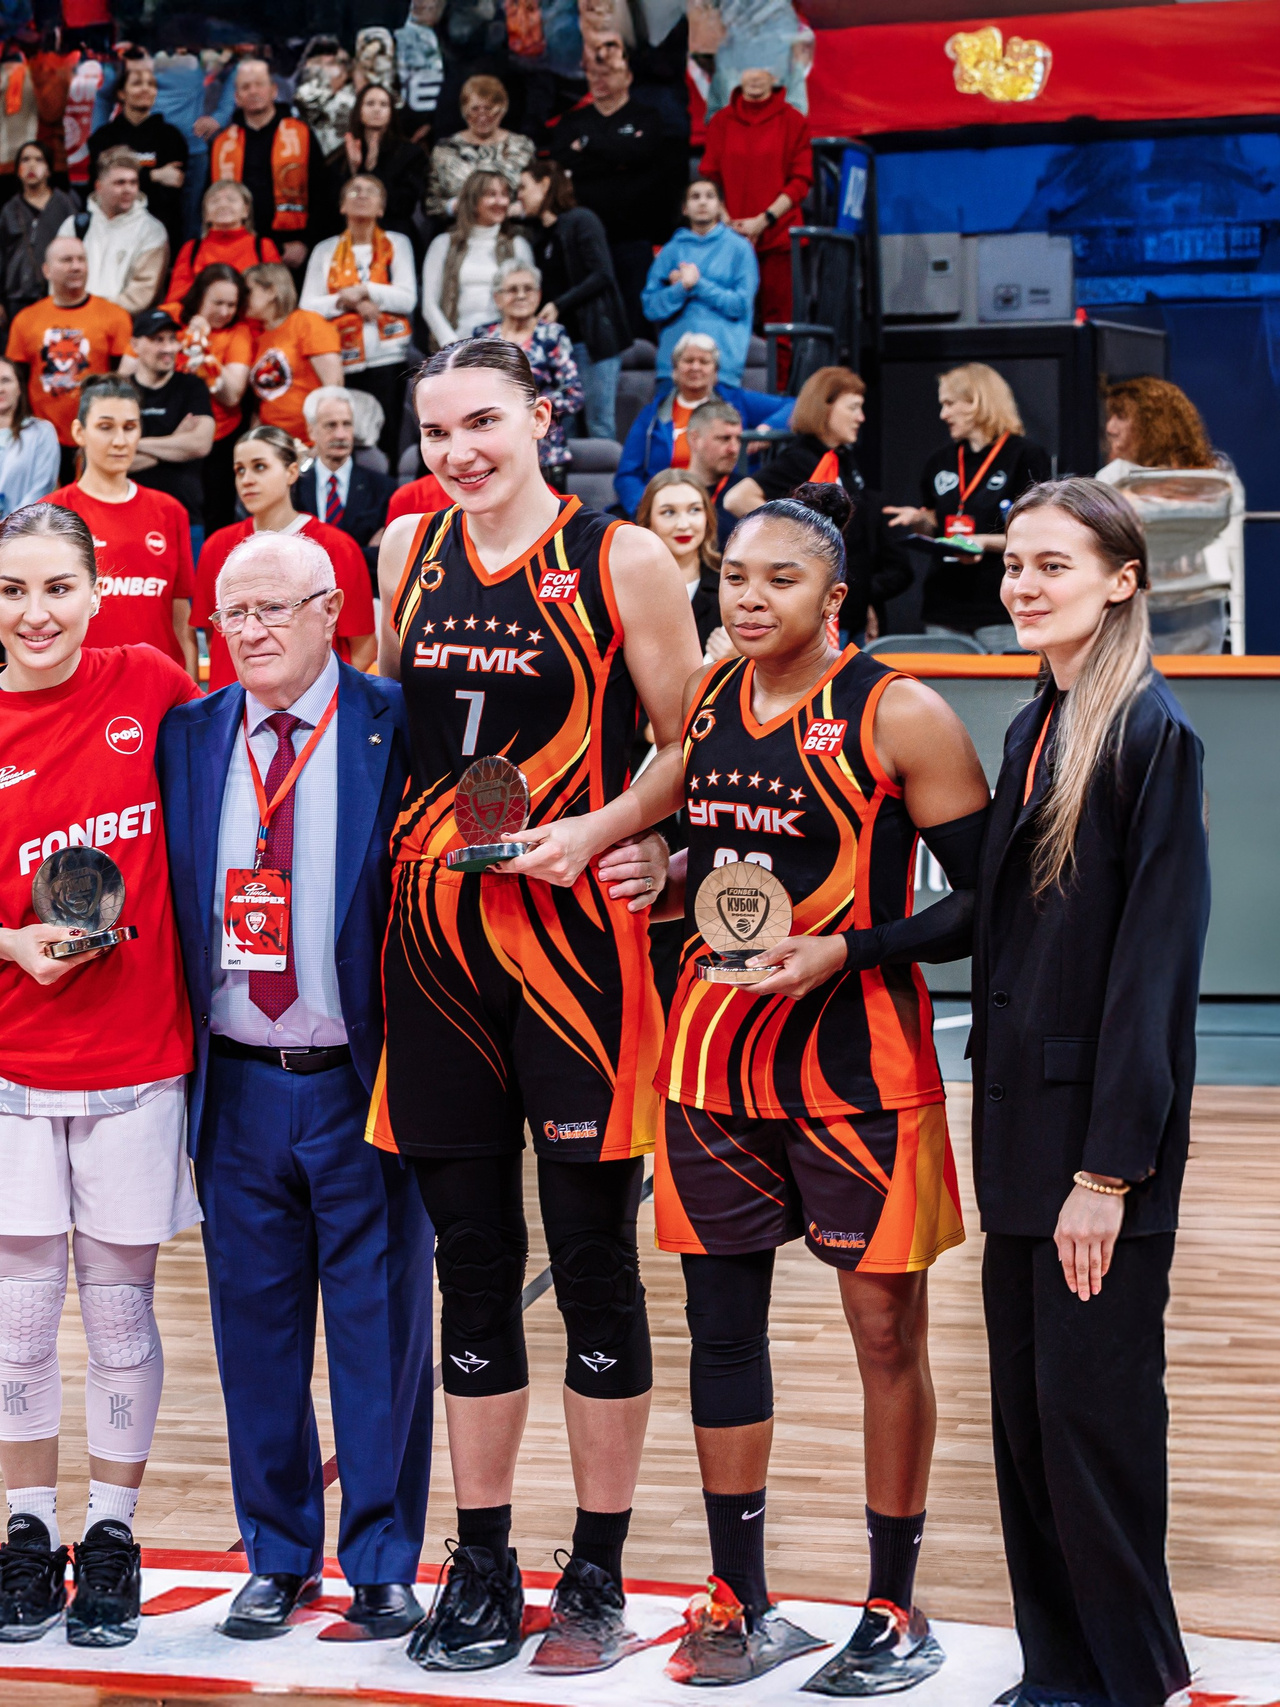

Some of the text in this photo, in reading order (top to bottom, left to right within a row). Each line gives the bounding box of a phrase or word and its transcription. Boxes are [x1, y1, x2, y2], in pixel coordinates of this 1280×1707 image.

[97, 576, 167, 597] ONBET
[542, 572, 578, 585] FON
[539, 585, 576, 599] BET
[413, 642, 544, 677] УГМК
[455, 689, 485, 756] 7
[807, 722, 845, 737] FON
[110, 727, 140, 744] РФБ
[803, 736, 840, 751] BET
[688, 798, 807, 838] УГМК
[18, 801, 157, 877] FONBET
[728, 888, 758, 896] FONBET
[727, 897, 760, 913] КУБОК
